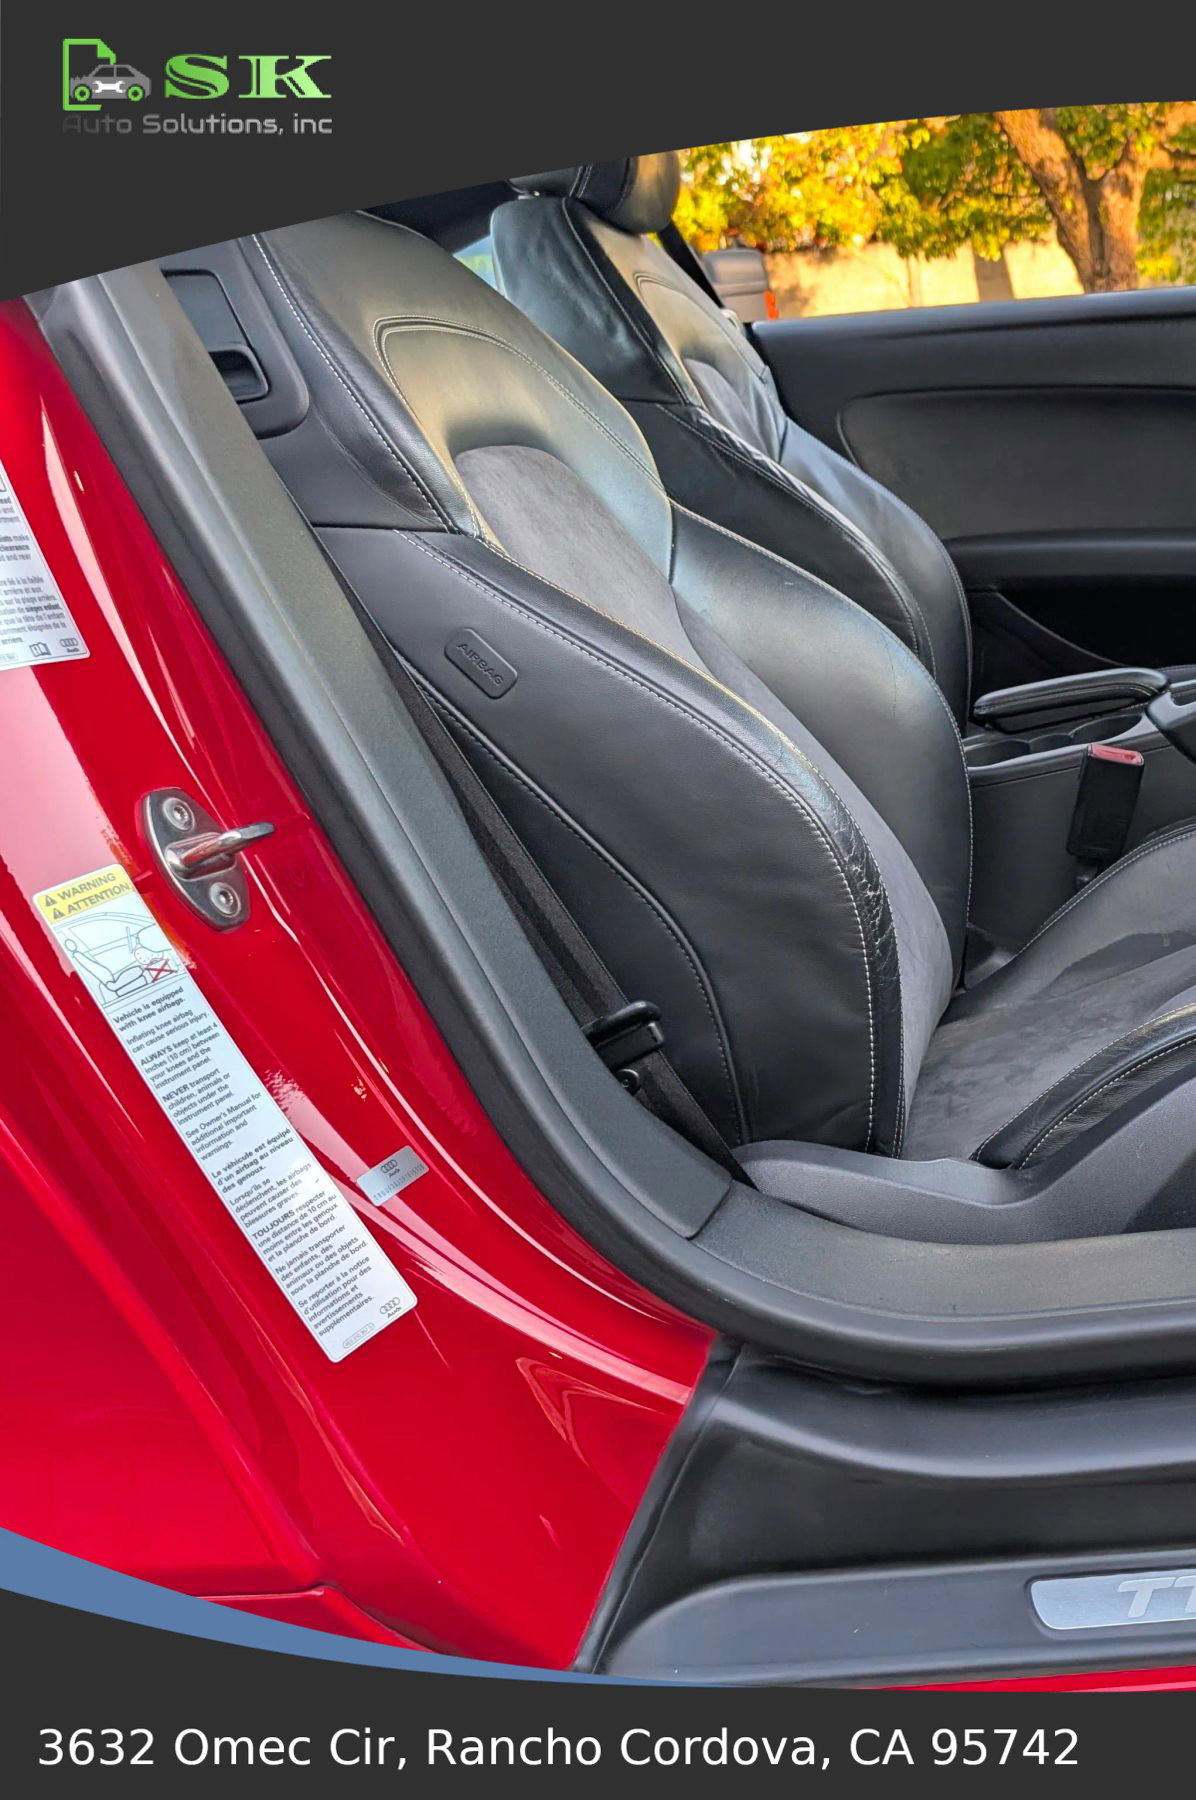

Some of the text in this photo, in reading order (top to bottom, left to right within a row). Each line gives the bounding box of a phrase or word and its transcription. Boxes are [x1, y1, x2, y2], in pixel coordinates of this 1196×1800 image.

[457, 643, 504, 686] AIRBAG
[57, 873, 117, 900] WARNING
[64, 882, 131, 913] ATTENTION
[113, 1006, 142, 1023] Vehicle
[150, 986, 184, 1007] equipped
[118, 996, 186, 1032] with knee airbags.
[155, 1019, 172, 1030] knee
[171, 1008, 193, 1023] airbag
[132, 1044, 145, 1053] can
[145, 1034, 165, 1046] cause
[165, 1021, 189, 1036] serious
[139, 1046, 173, 1065] ALWAYS
[172, 1037, 190, 1049] keep
[197, 1025, 213, 1036] least
[144, 1059, 167, 1073] inches
[192, 1032, 220, 1049] between
[150, 1046, 211, 1082] your knees and the
[154, 1067, 192, 1089] instrument
[162, 1069, 220, 1102] NEVER transport
[173, 1084, 229, 1118] objects under the
[196, 1077, 223, 1093] animals
[177, 1102, 214, 1125] instrument
[186, 1127, 199, 1138] See
[226, 1097, 251, 1114] Manual
[251, 1091, 261, 1100] for
[190, 1105, 257, 1145] additional important
[195, 1120, 248, 1153] information and
[212, 1128, 291, 1178] Le véhicule est équipé
[235, 1158, 259, 1175] airbag
[259, 1152, 269, 1160] au
[269, 1137, 294, 1154] niveau
[222, 1183, 235, 1193] des
[262, 1178, 270, 1186] se
[267, 1187, 289, 1203] causer
[276, 1177, 287, 1187] les
[252, 1210, 295, 1240] TOUJOURS
[258, 1236, 271, 1248] une
[270, 1217, 299, 1239] distance
[298, 1211, 308, 1221] de
[308, 1206, 316, 1214] 10
[316, 1199, 328, 1209] cm
[284, 1226, 302, 1241] entre
[302, 1219, 312, 1228] les
[267, 1254, 275, 1262] et
[275, 1249, 282, 1257] la
[282, 1231, 310, 1253] planche
[308, 1225, 318, 1234] de
[285, 1249, 309, 1268] jamais
[308, 1224, 346, 1253] transporter
[280, 1269, 293, 1281] des
[320, 1243, 333, 1254] des
[285, 1236, 359, 1288] animaux ou des objets
[314, 1259, 341, 1280] planche
[340, 1252, 350, 1261] de
[342, 1274, 358, 1288] pour
[358, 1264, 371, 1276] des
[298, 1298, 308, 1308] Se
[308, 1279, 336, 1302] reporter
[341, 1270, 348, 1278] la
[348, 1255, 369, 1273] notice
[308, 1284, 358, 1322] informations et
